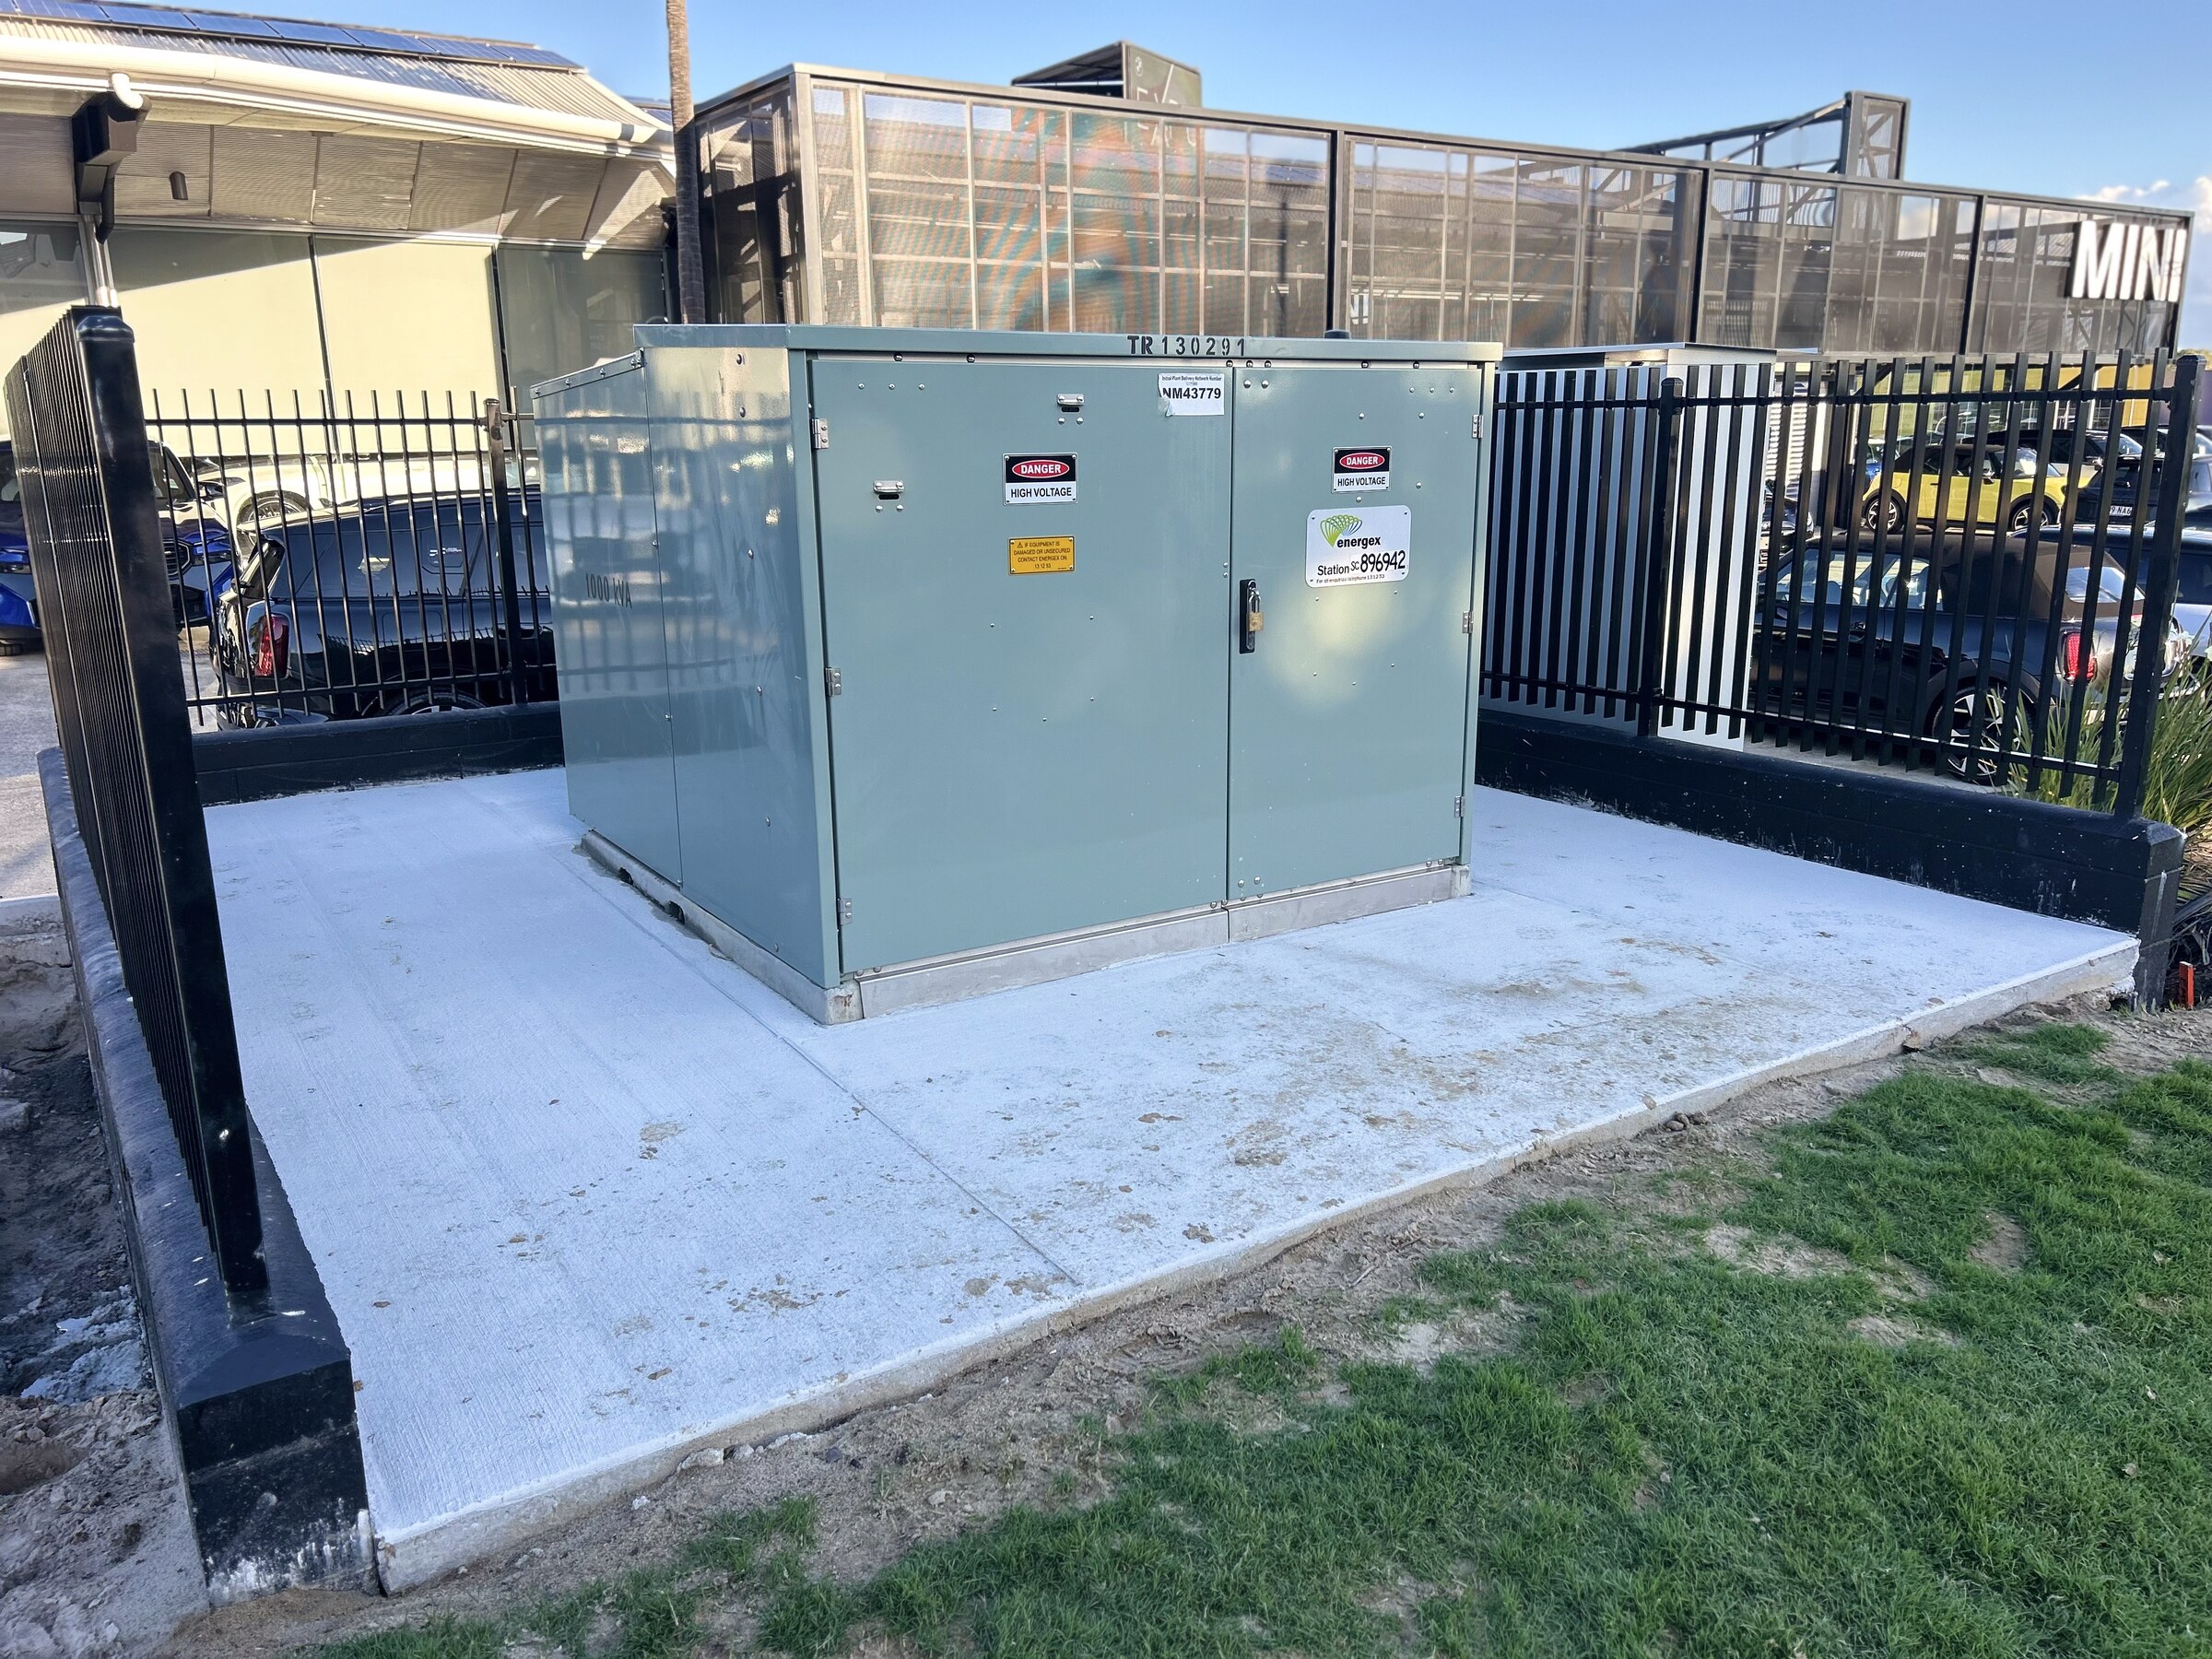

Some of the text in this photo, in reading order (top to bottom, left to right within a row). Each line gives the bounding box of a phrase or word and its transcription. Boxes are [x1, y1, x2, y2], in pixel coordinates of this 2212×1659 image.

[2072, 220, 2187, 302] MINI
[1162, 387, 1221, 399] NM43779
[1347, 456, 1378, 465] DANGER
[1020, 465, 1062, 474] DANGER
[1337, 477, 1386, 487] HIGH VOLTAGE
[1011, 488, 1072, 498] HIGH VOLTAGE
[1336, 536, 1381, 549] energex
[1317, 564, 1349, 576] Station
[585, 572, 633, 609] 1000 kVA
